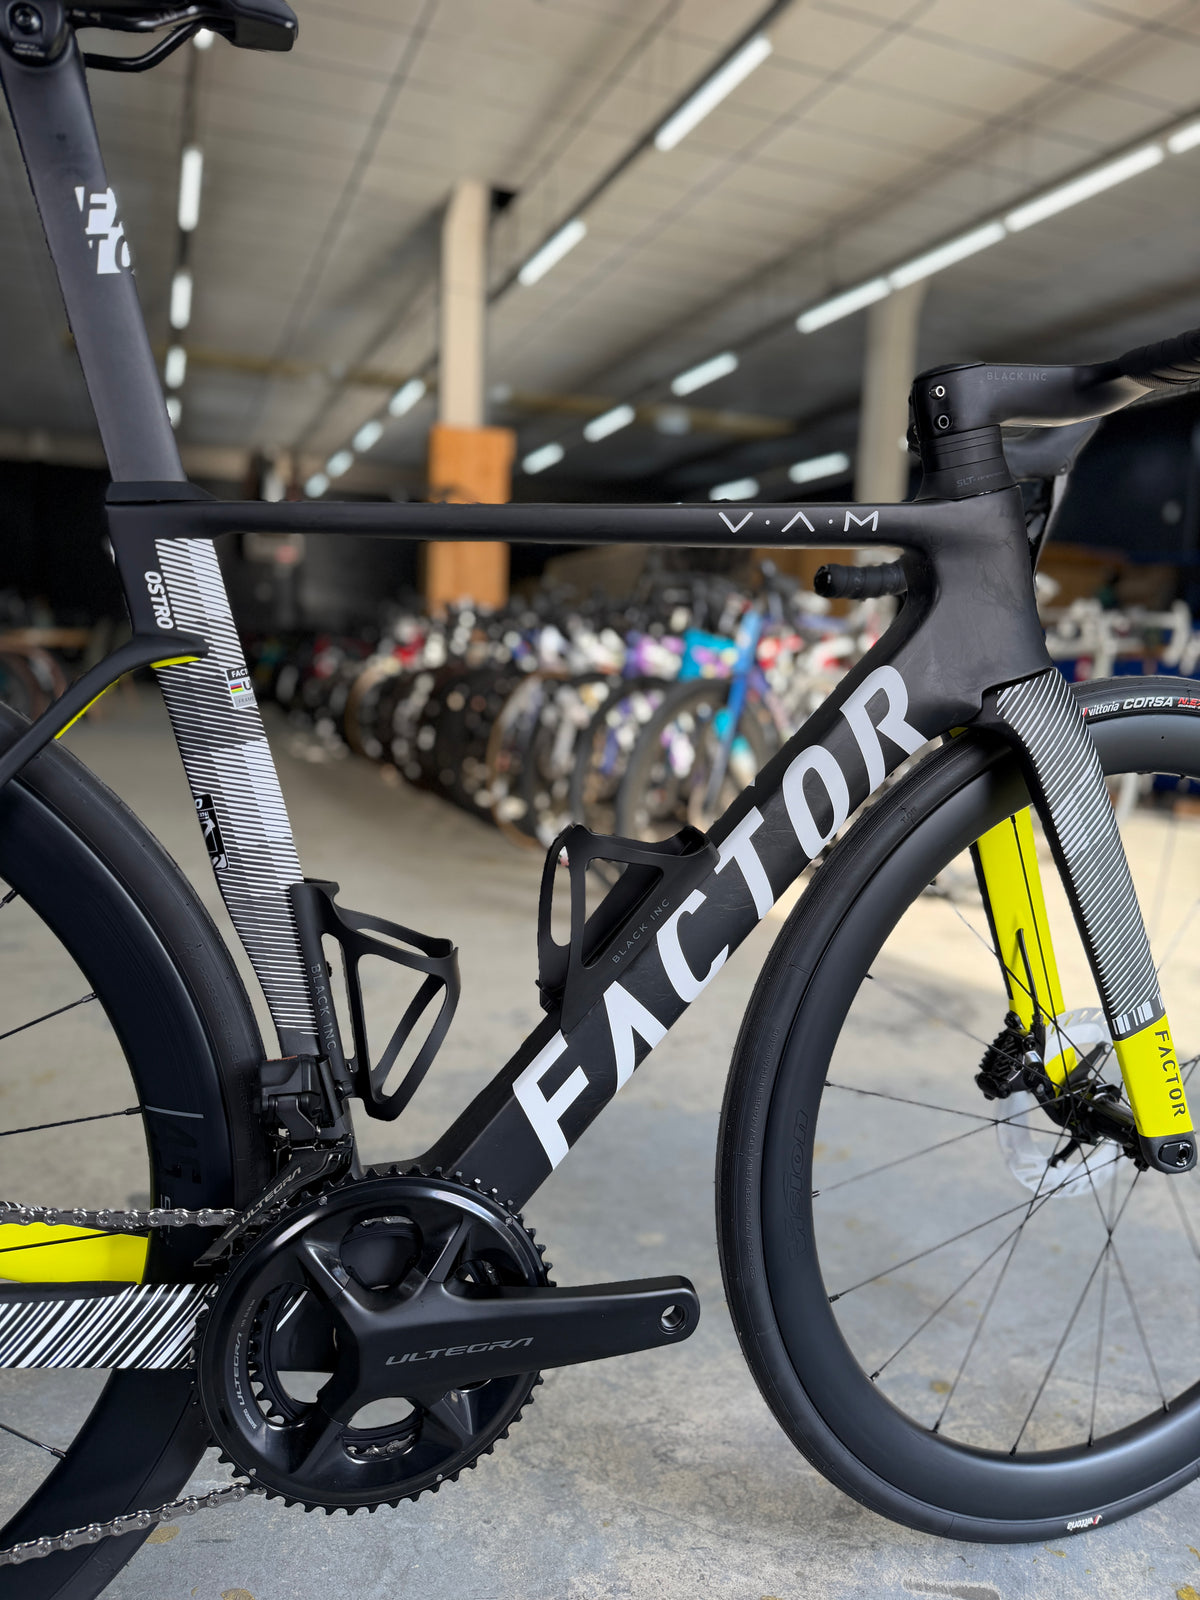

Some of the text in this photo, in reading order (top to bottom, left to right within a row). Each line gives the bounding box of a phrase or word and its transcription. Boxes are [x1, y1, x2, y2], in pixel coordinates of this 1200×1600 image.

[986, 371, 1048, 382] BLACK INC
[144, 571, 174, 630] OSTRO
[1088, 700, 1120, 717] vittoria
[1122, 696, 1174, 710] CORSA
[512, 665, 929, 1171] FACTOR
[612, 899, 670, 964] BLACK INC
[311, 963, 337, 1050] BLACK INC
[1154, 1030, 1186, 1118] FACTOR
[241, 1167, 301, 1223] ULTEGRA
[233, 1332, 246, 1405] ULTEGRA
[385, 1337, 534, 1366] ULTEGRA
